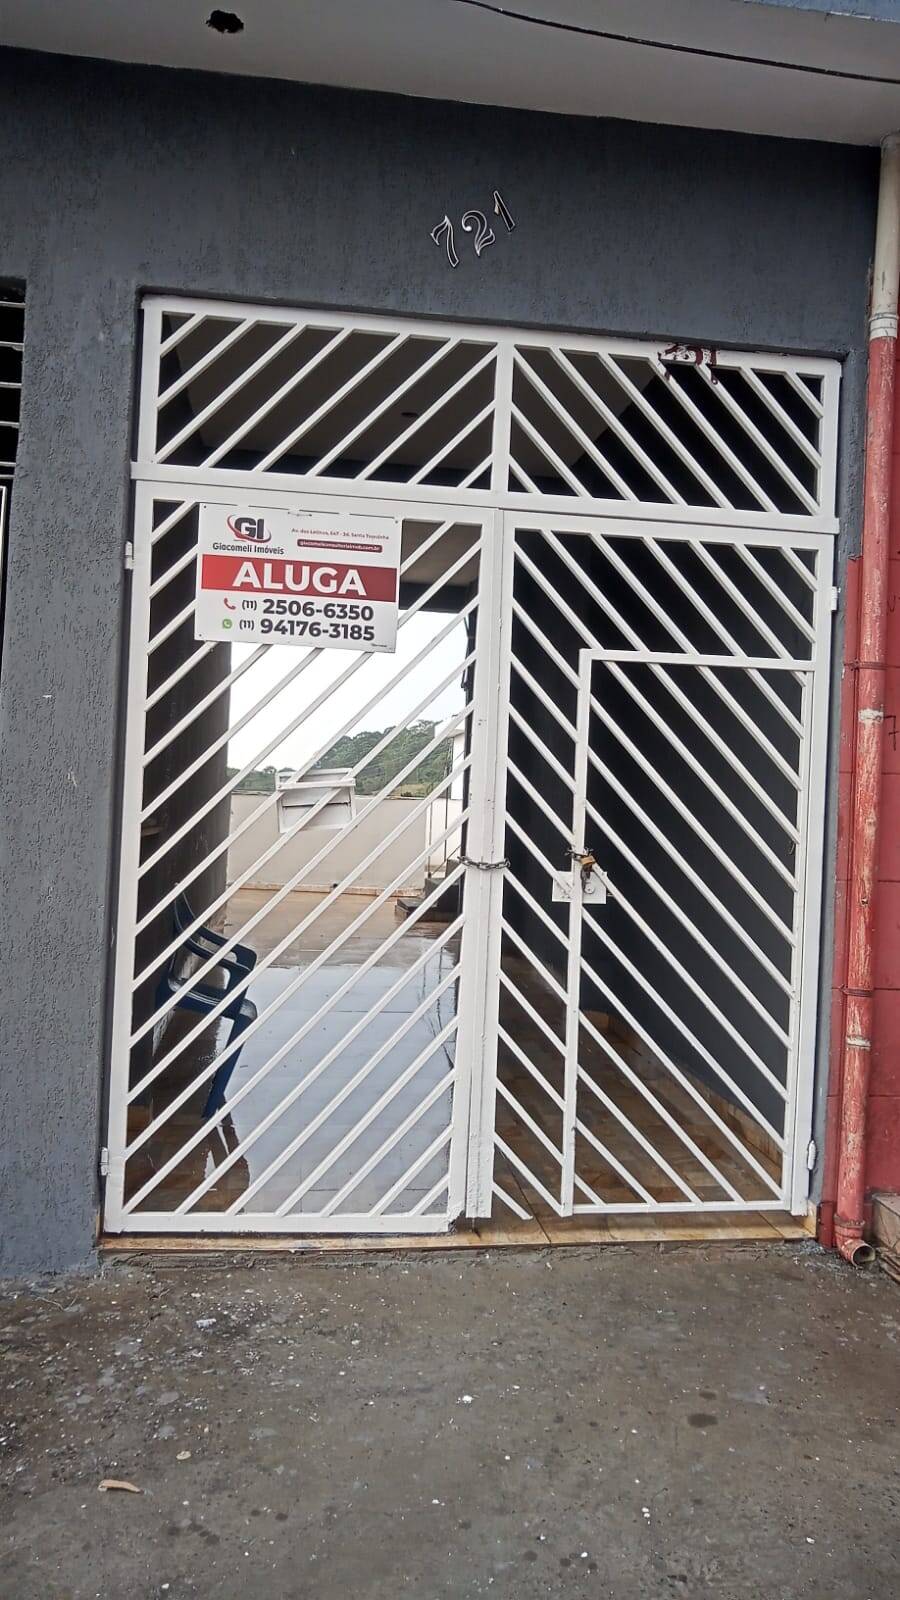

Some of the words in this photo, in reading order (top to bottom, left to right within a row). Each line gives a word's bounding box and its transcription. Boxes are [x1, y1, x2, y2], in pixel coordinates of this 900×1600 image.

[431, 190, 515, 267] 721
[234, 517, 264, 540] GI
[212, 542, 252, 553] Giacomeli
[254, 545, 284, 555] Imóveis
[232, 561, 367, 596] ALUGA
[242, 600, 257, 610] (11)
[262, 598, 374, 621] 2506-6350
[239, 620, 254, 631] (11)
[260, 618, 375, 641] 94176-3185
